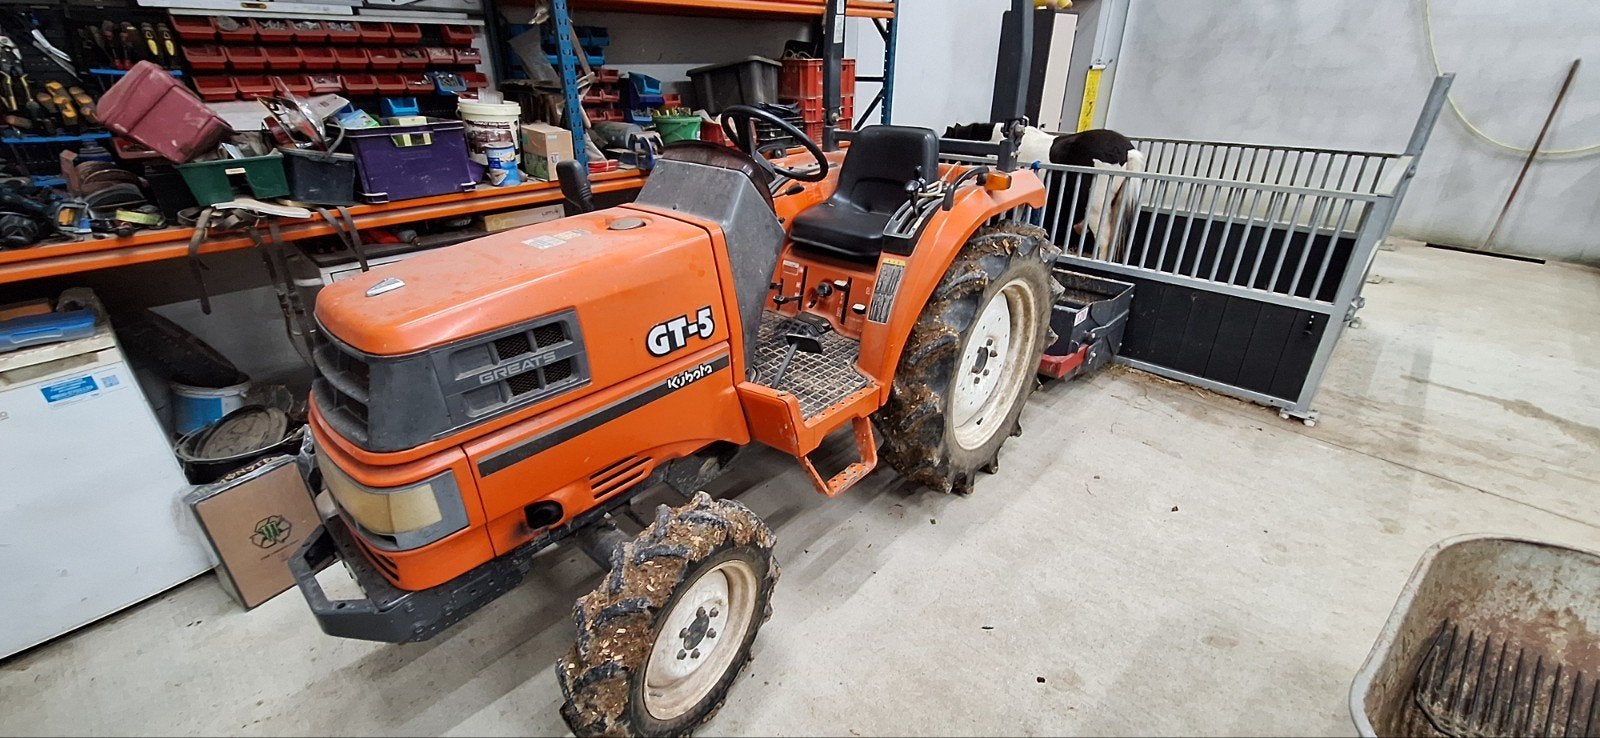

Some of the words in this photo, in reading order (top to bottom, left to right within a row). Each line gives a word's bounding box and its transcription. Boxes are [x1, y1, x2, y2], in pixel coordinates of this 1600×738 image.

[646, 306, 715, 356] GT-5
[479, 351, 556, 384] GREATS
[667, 364, 713, 389] Kubota
